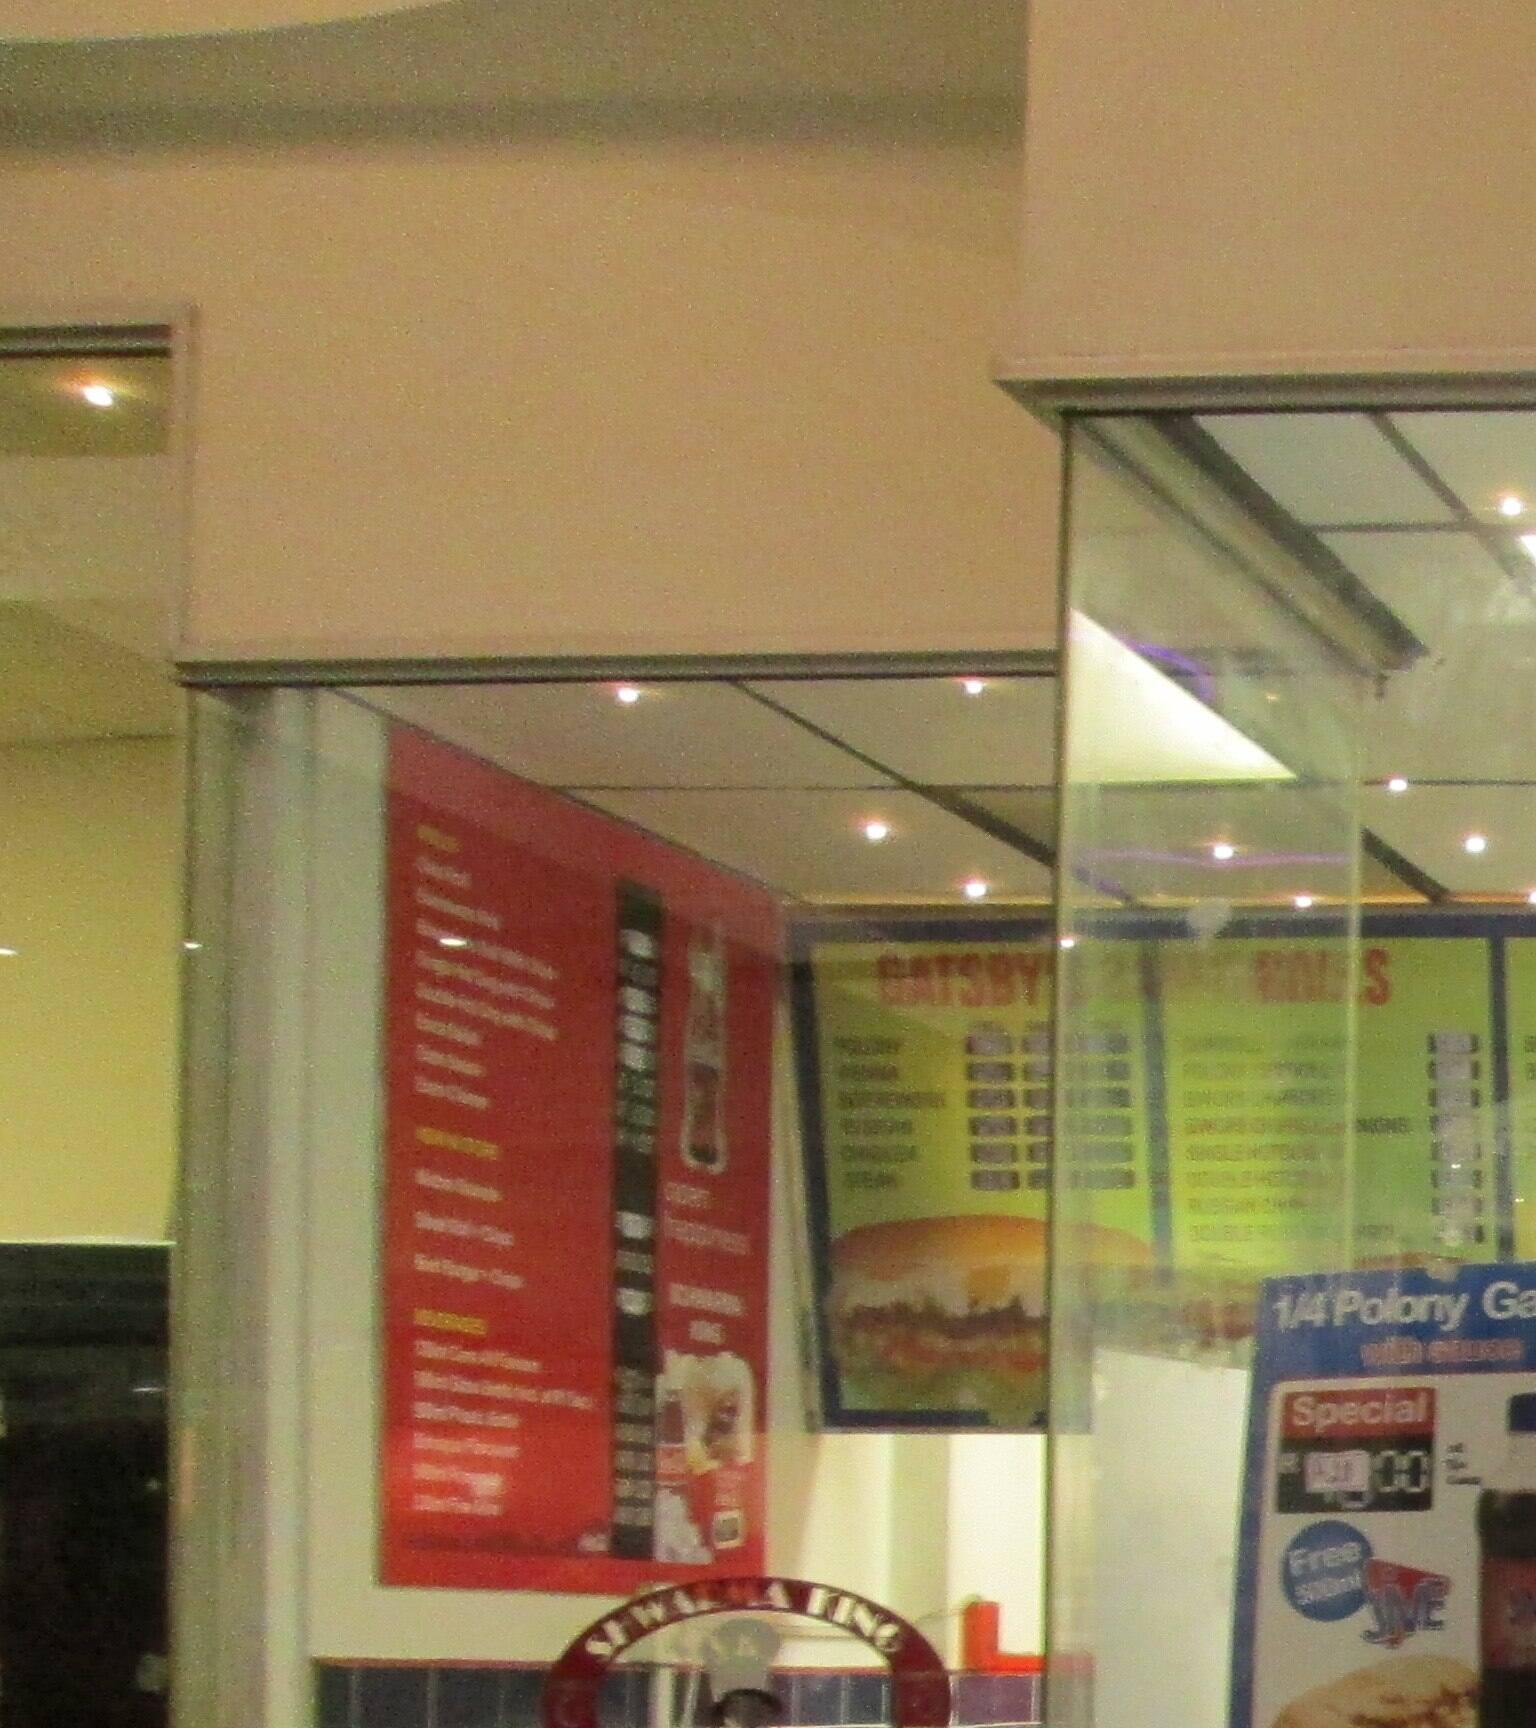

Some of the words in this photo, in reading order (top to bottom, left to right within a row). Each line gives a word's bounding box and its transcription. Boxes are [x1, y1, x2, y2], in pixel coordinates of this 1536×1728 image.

[1333, 1288, 1470, 1331] Polony
[1292, 1391, 1428, 1432] Special
[1289, 1541, 1361, 1577] Free
